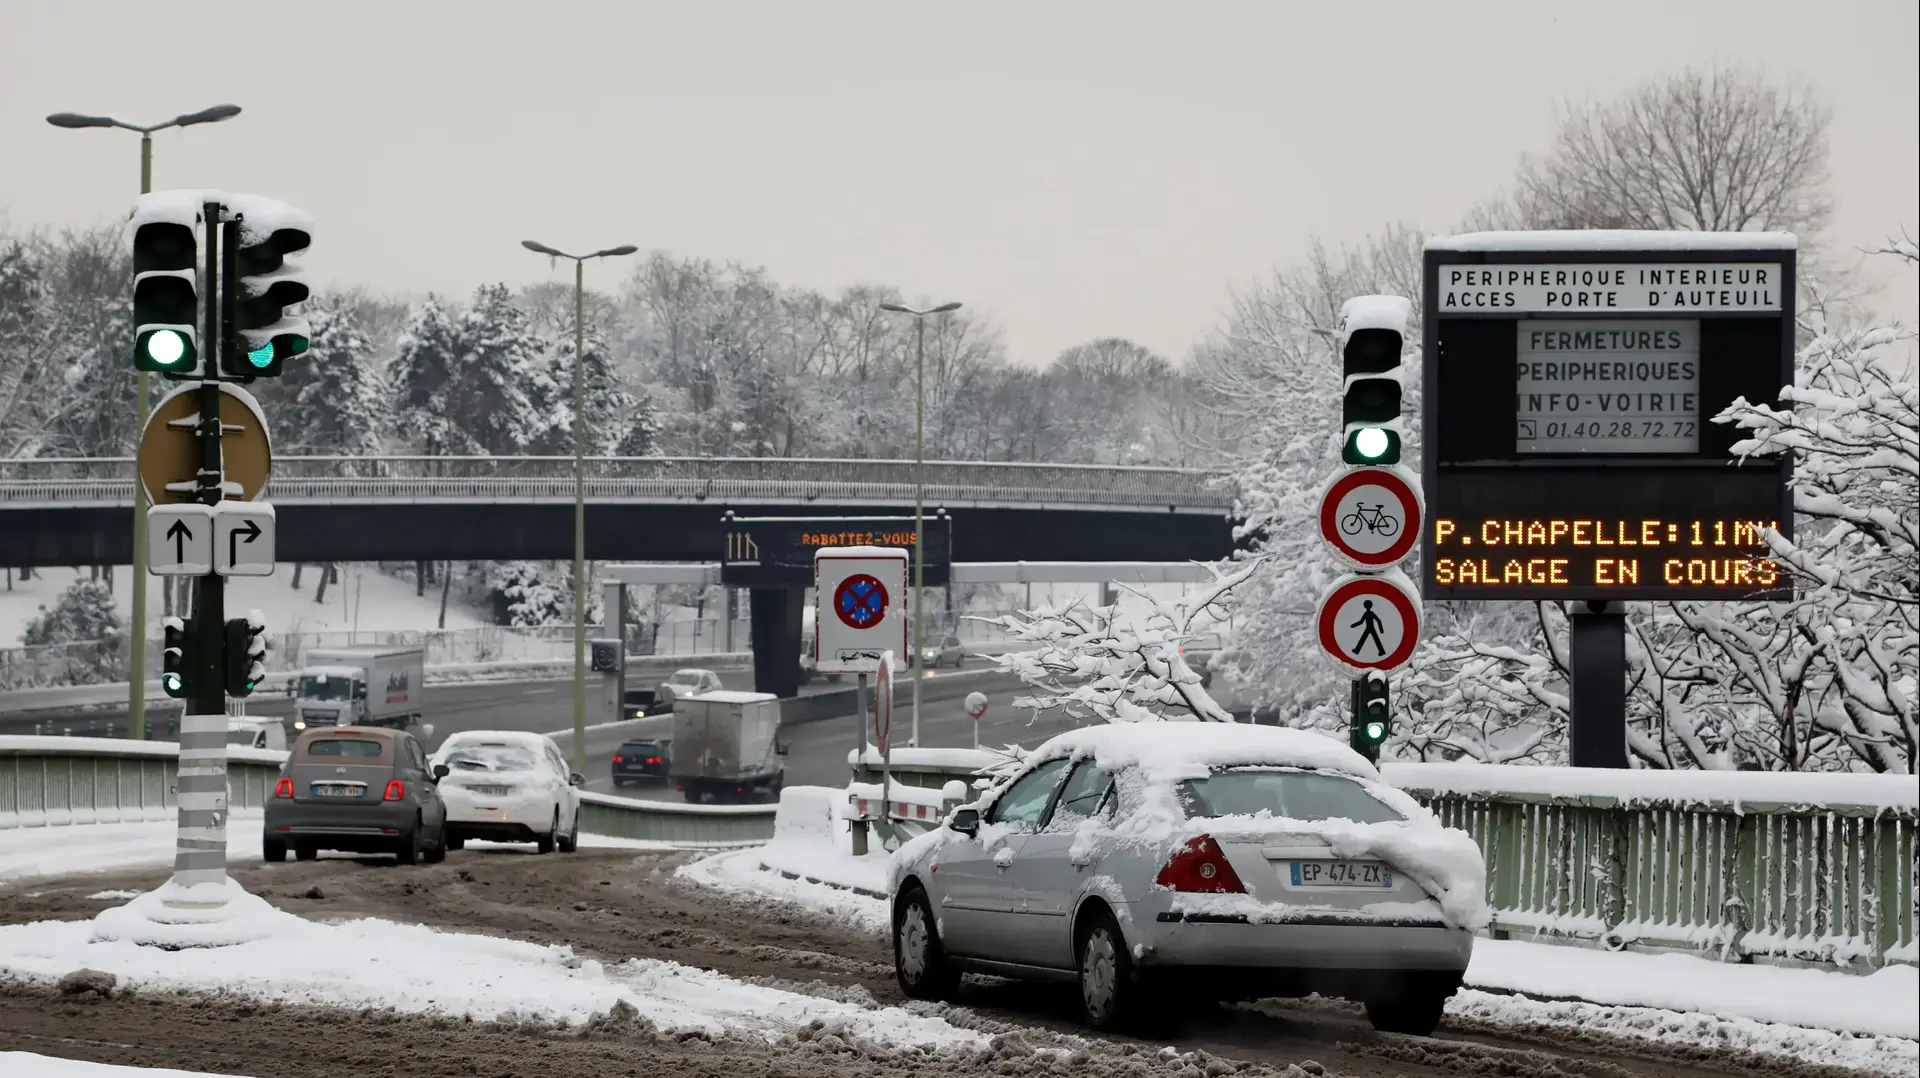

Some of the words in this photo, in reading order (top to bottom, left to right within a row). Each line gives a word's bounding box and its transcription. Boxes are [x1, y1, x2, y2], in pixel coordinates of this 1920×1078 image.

[1451, 270, 1626, 286] PERIPHERIQUE
[1640, 269, 1767, 285] INTERIEUR
[1446, 291, 1516, 307] ACCES
[1547, 291, 1617, 307] PORTE
[1649, 290, 1774, 307] D'AUTEUIL
[1531, 331, 1681, 350] FERMETURES
[1517, 361, 1696, 382] PERIPHERIQUES
[1517, 392, 1696, 412] INFO-VOIRIE
[1546, 421, 1696, 438] 01.40.28.72.72
[802, 533, 917, 545] RABATTEZ-VOUS
[1435, 558, 1570, 585] SALAGE
[1595, 558, 1638, 585] EN
[1664, 558, 1777, 585] COURS
[1302, 864, 1381, 882] EP-474-ZX
